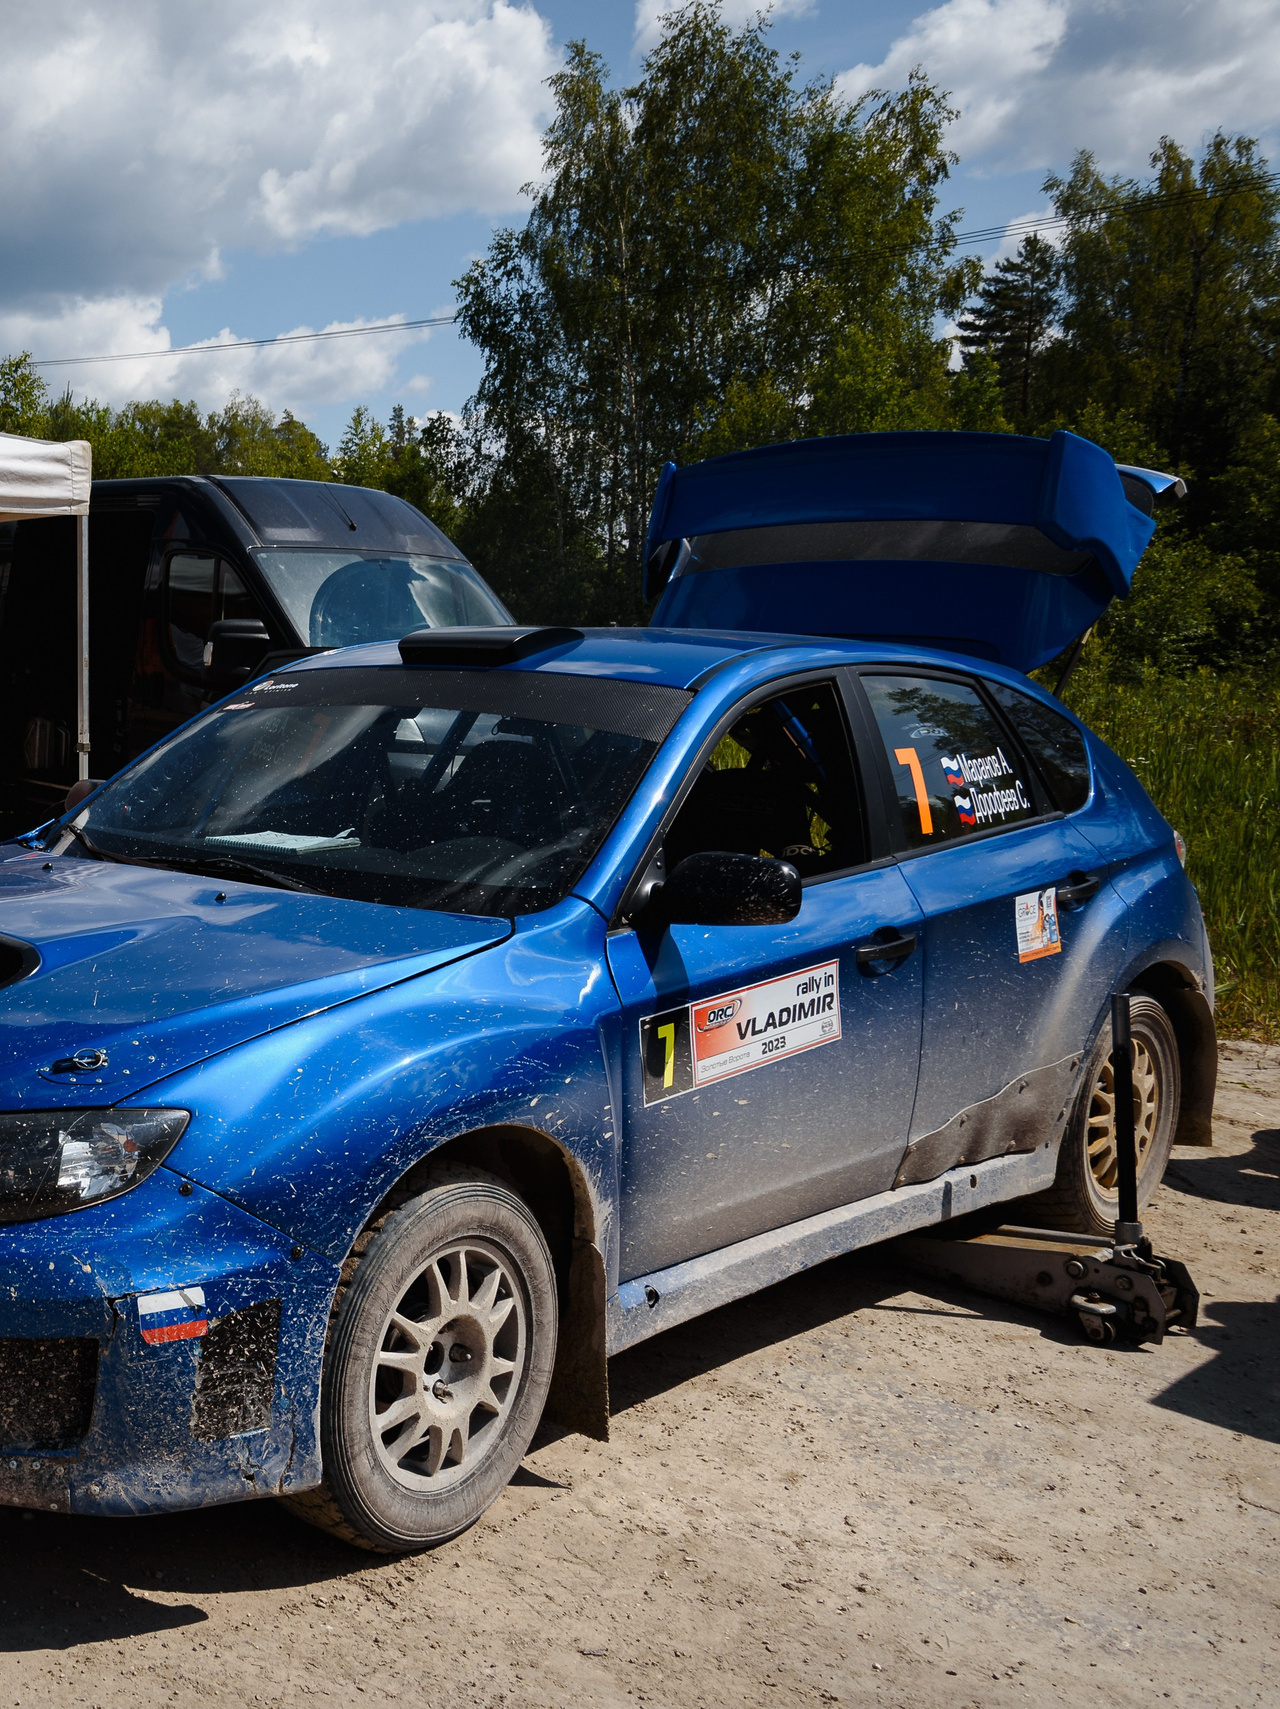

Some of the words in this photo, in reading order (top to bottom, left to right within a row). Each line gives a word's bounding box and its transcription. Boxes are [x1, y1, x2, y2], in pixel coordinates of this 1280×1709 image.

[956, 753, 1002, 788] Маранов
[996, 746, 1013, 775] А.
[969, 784, 1020, 824] Дорофеев
[1015, 780, 1031, 810] С.
[796, 976, 823, 997] rally
[823, 972, 834, 989] in
[706, 1004, 735, 1023] ORC
[736, 991, 836, 1041] VLADIMIR
[700, 1059, 728, 1074] Золотые
[728, 1051, 751, 1066] Ворота
[761, 1035, 787, 1055] 2023
